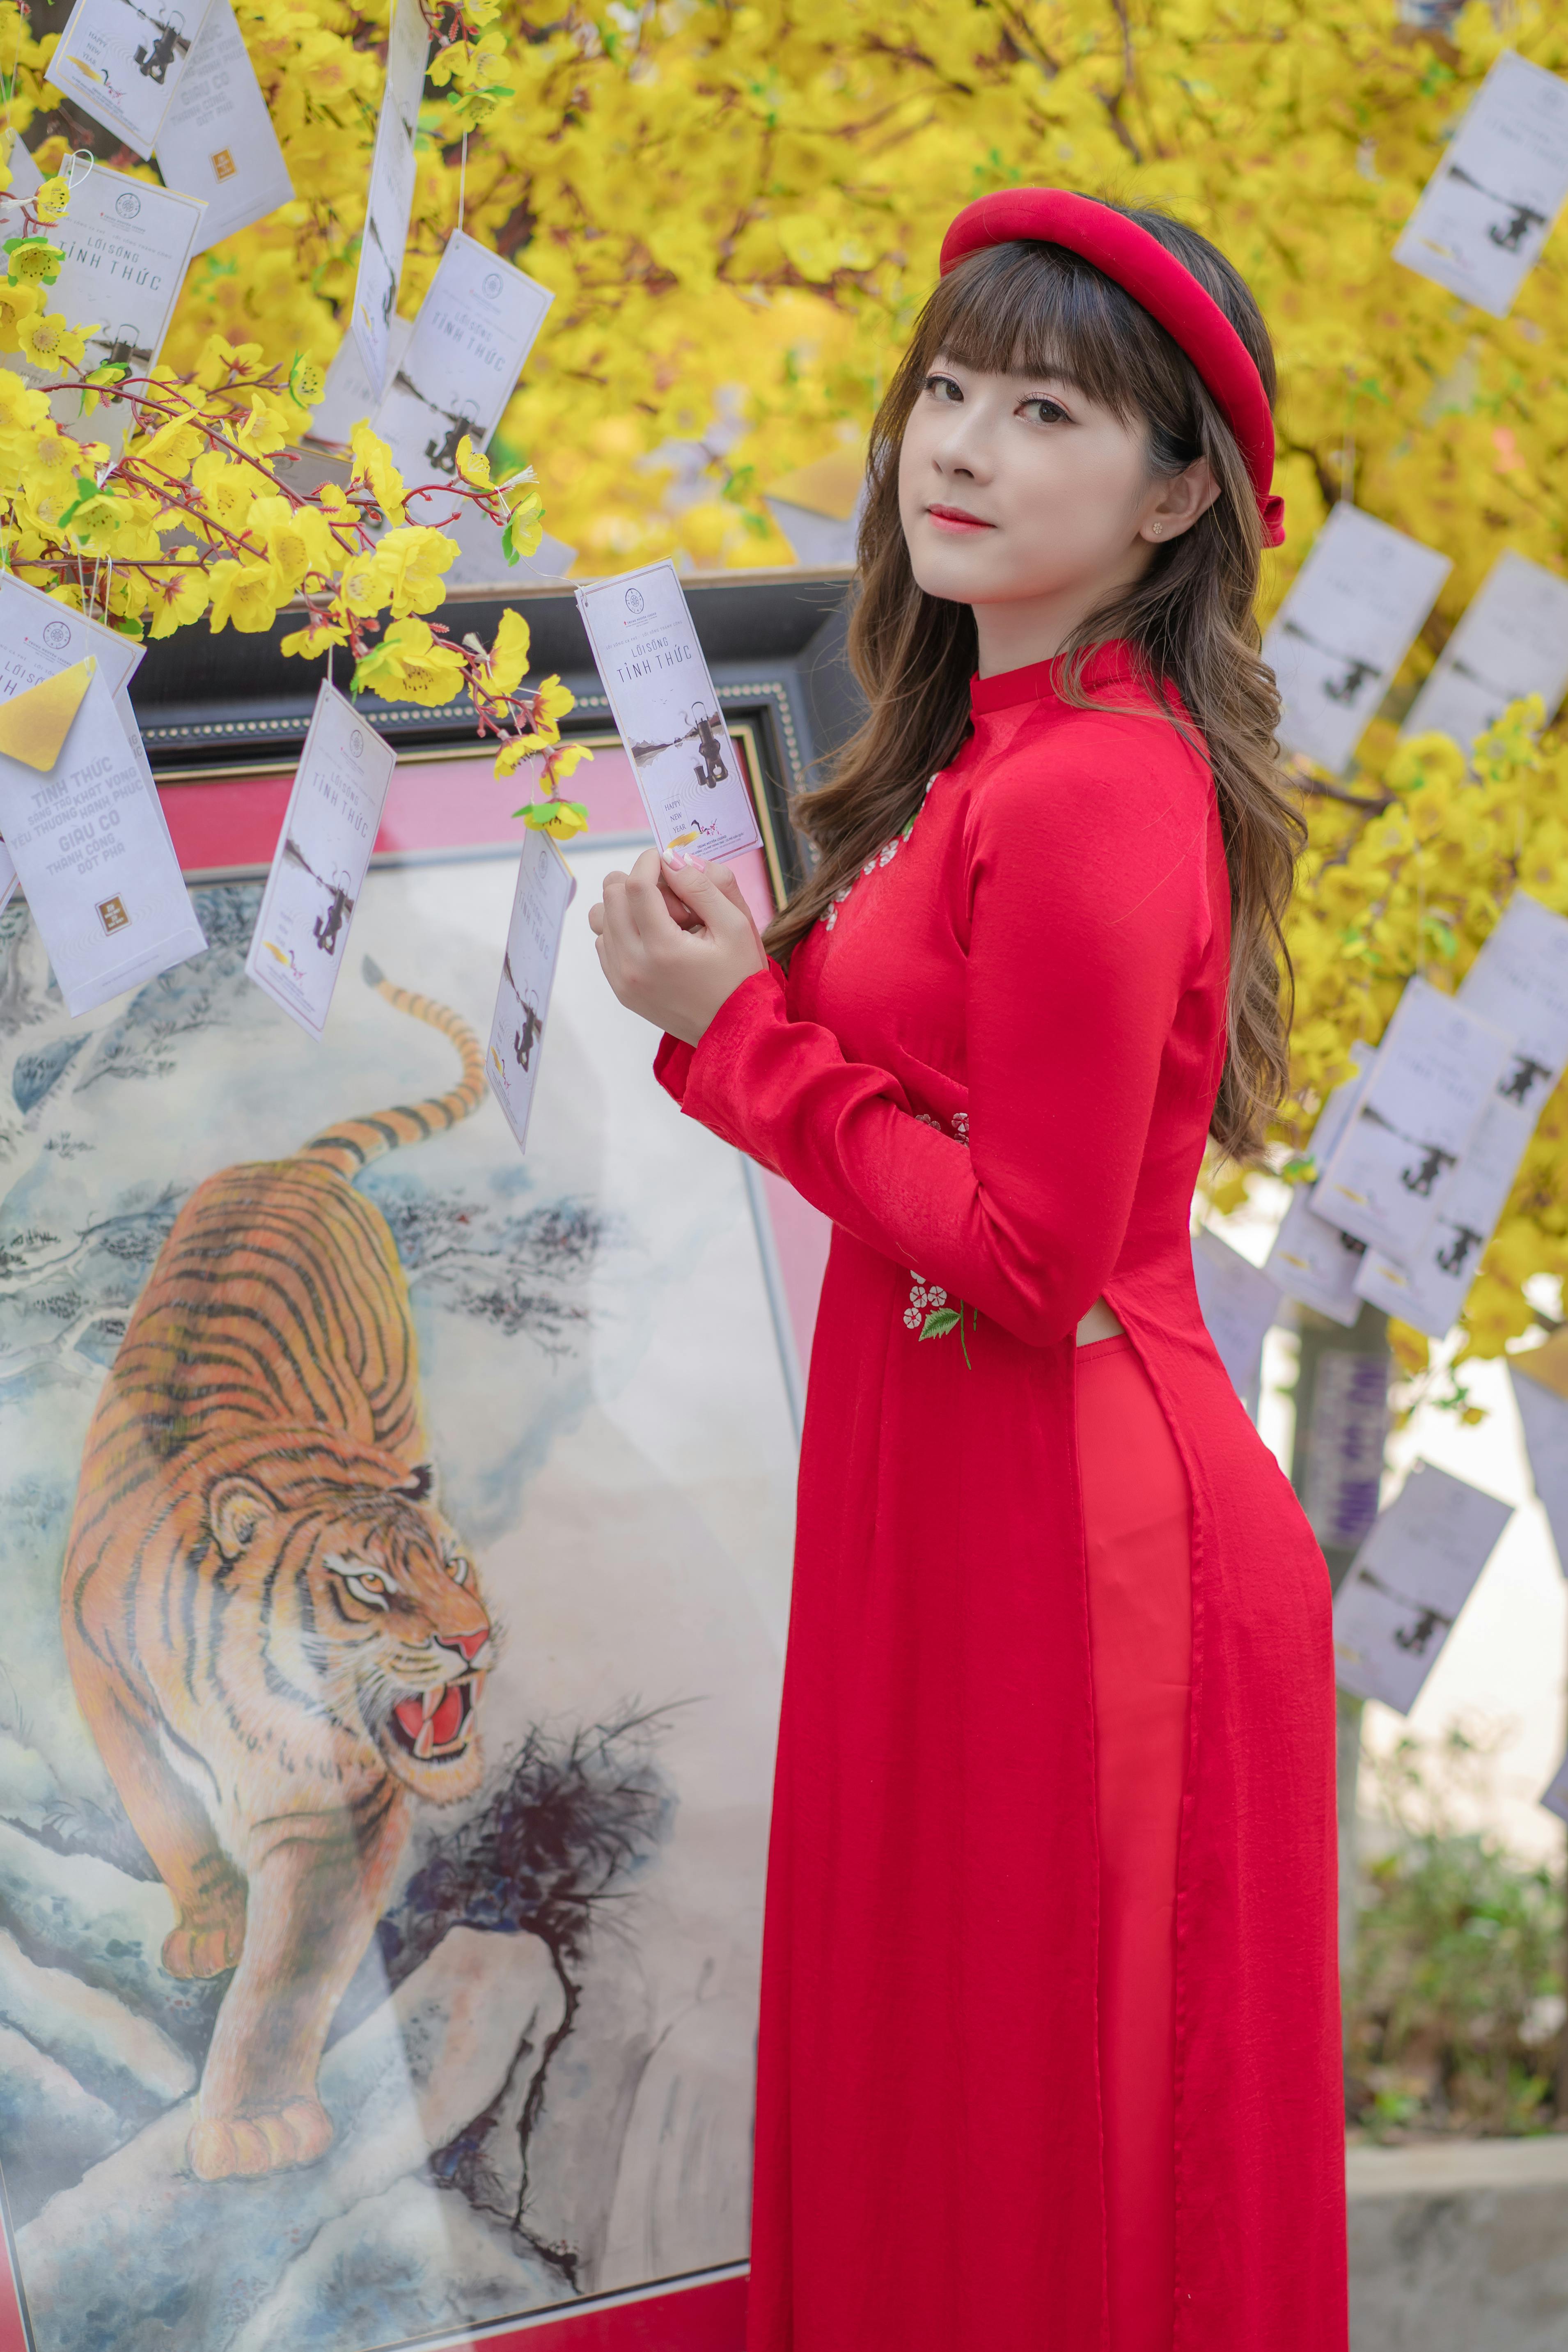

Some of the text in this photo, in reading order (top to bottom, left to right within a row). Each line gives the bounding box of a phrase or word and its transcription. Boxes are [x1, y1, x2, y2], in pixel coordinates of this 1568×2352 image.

[59, 240, 162, 291] TỈNH THỨC
[617, 644, 692, 683] TỈNH THỨC
[313, 771, 339, 807] TỈNH
[342, 801, 369, 838] THỨC
[664, 799, 681, 812] HAPPY
[669, 812, 682, 822] NEW
[58, 803, 121, 852] GIÀU CÓ
[672, 823, 687, 834] YEAR
